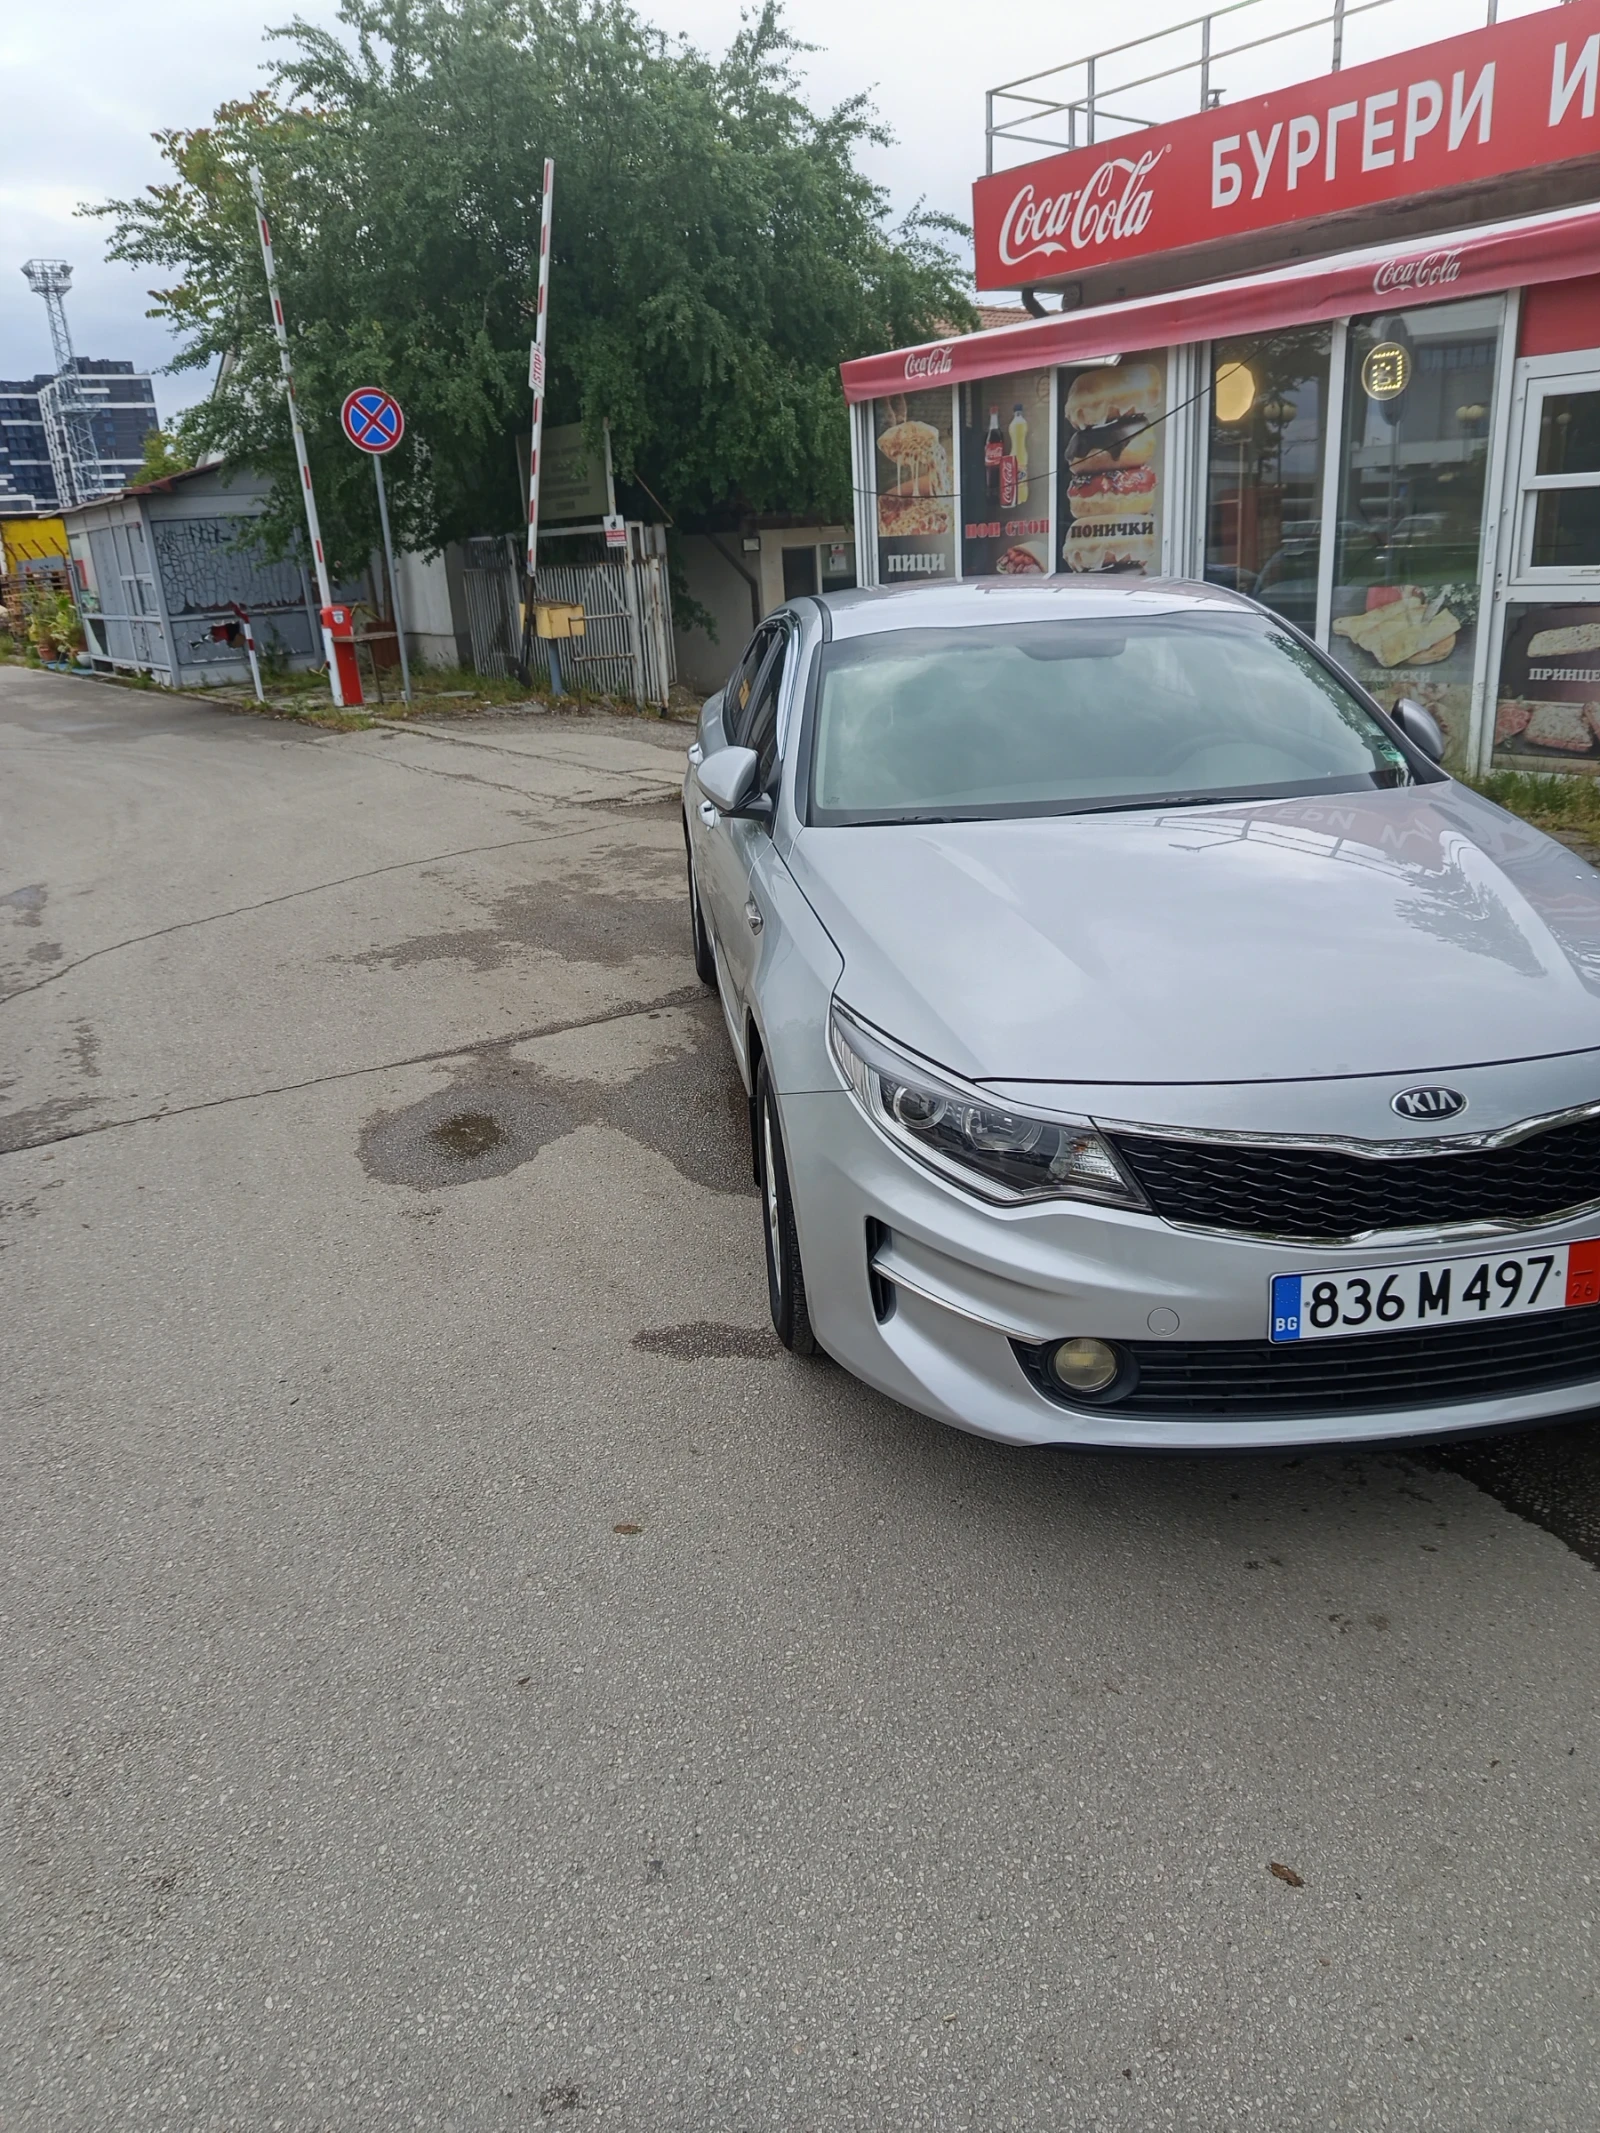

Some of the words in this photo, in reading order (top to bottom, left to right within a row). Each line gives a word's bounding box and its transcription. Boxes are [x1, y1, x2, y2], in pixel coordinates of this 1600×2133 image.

[1211, 62, 1497, 209] БУРГЕРИ
[1548, 32, 1600, 127] И
[1373, 247, 1466, 295] Coca-Cola
[532, 352, 543, 384] STOP
[1070, 521, 1154, 538] ПОНИЧКИ
[887, 553, 946, 575] ПИЦИ
[1402, 1090, 1458, 1114] KIA
[1309, 1273, 1406, 1328] 836
[1417, 1267, 1452, 1319] M
[1461, 1254, 1555, 1311] 497
[1275, 1316, 1298, 1332] BG
